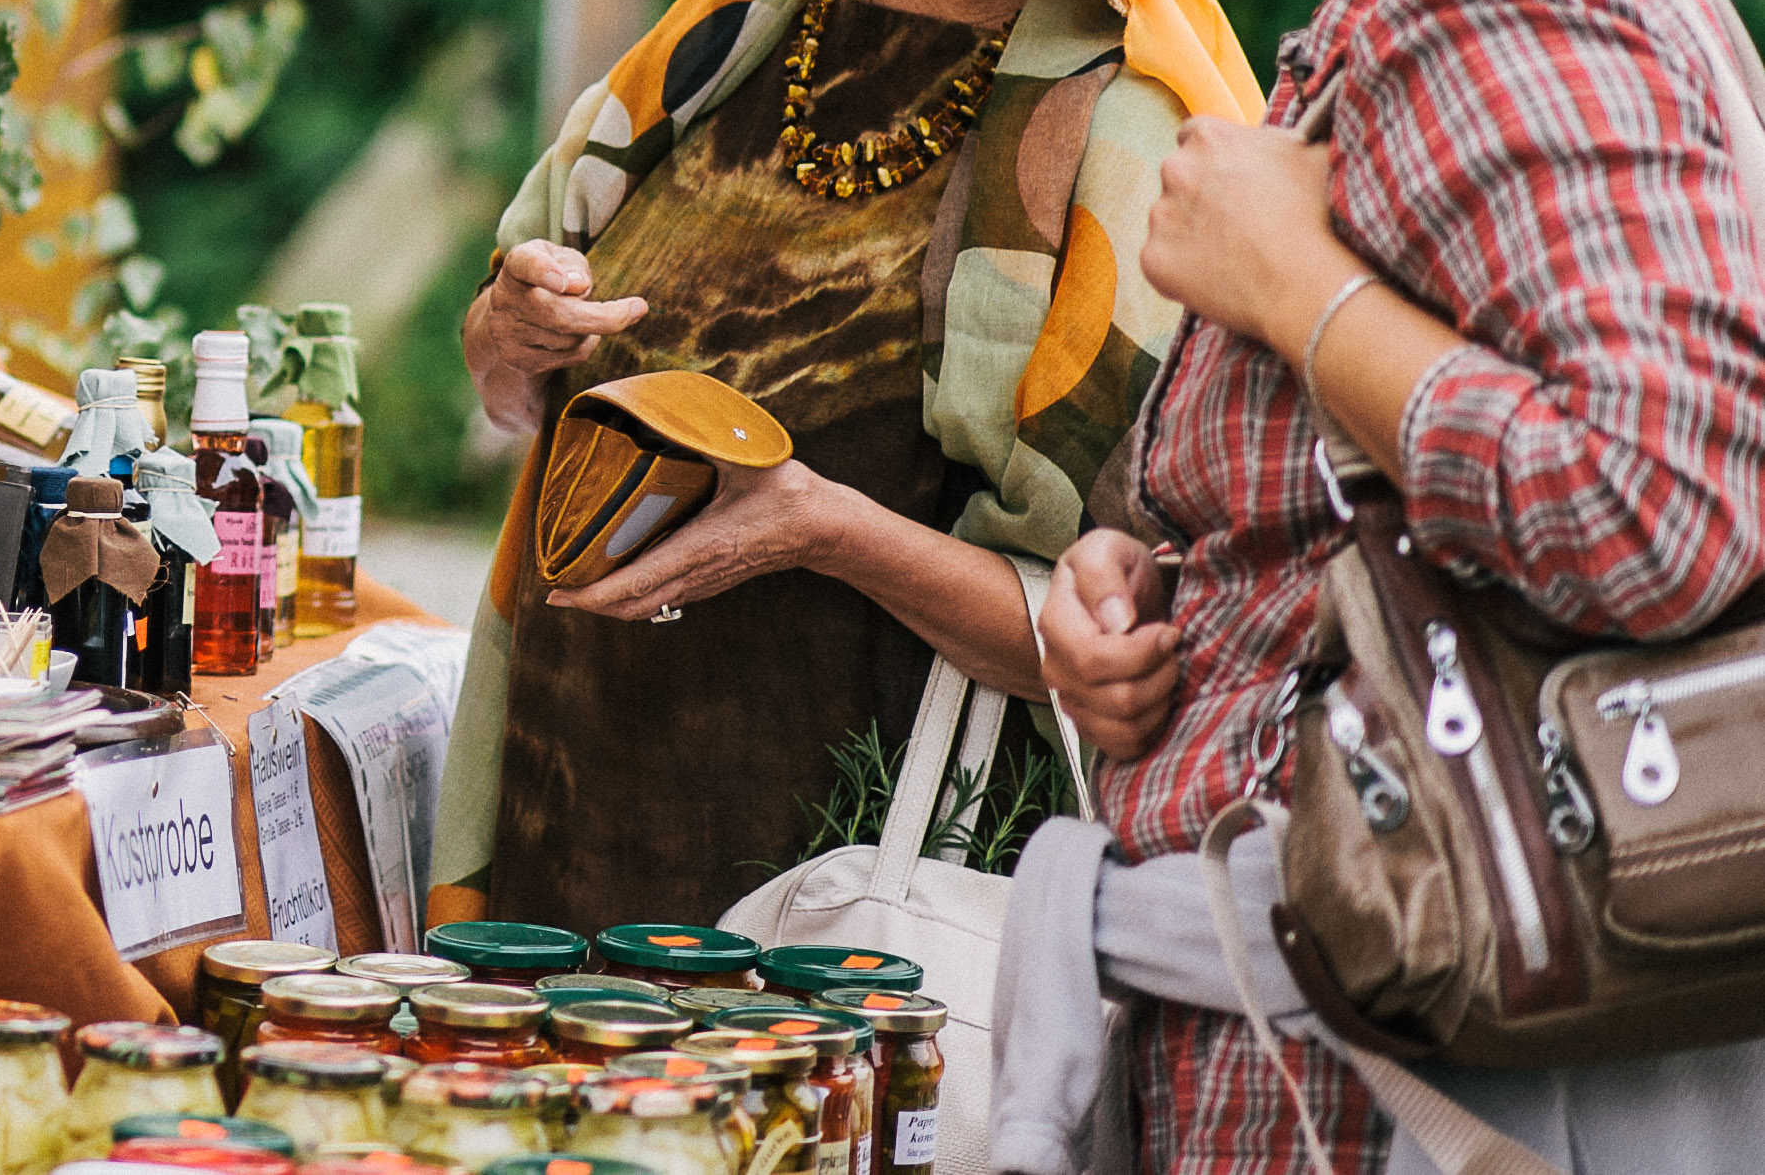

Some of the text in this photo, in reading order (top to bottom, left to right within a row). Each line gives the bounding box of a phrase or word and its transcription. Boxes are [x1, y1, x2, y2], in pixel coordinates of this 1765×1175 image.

[253, 735, 301, 787] Hauswein
[101, 797, 214, 899] Kostprobe
[272, 879, 326, 934] Fruchtlikör
